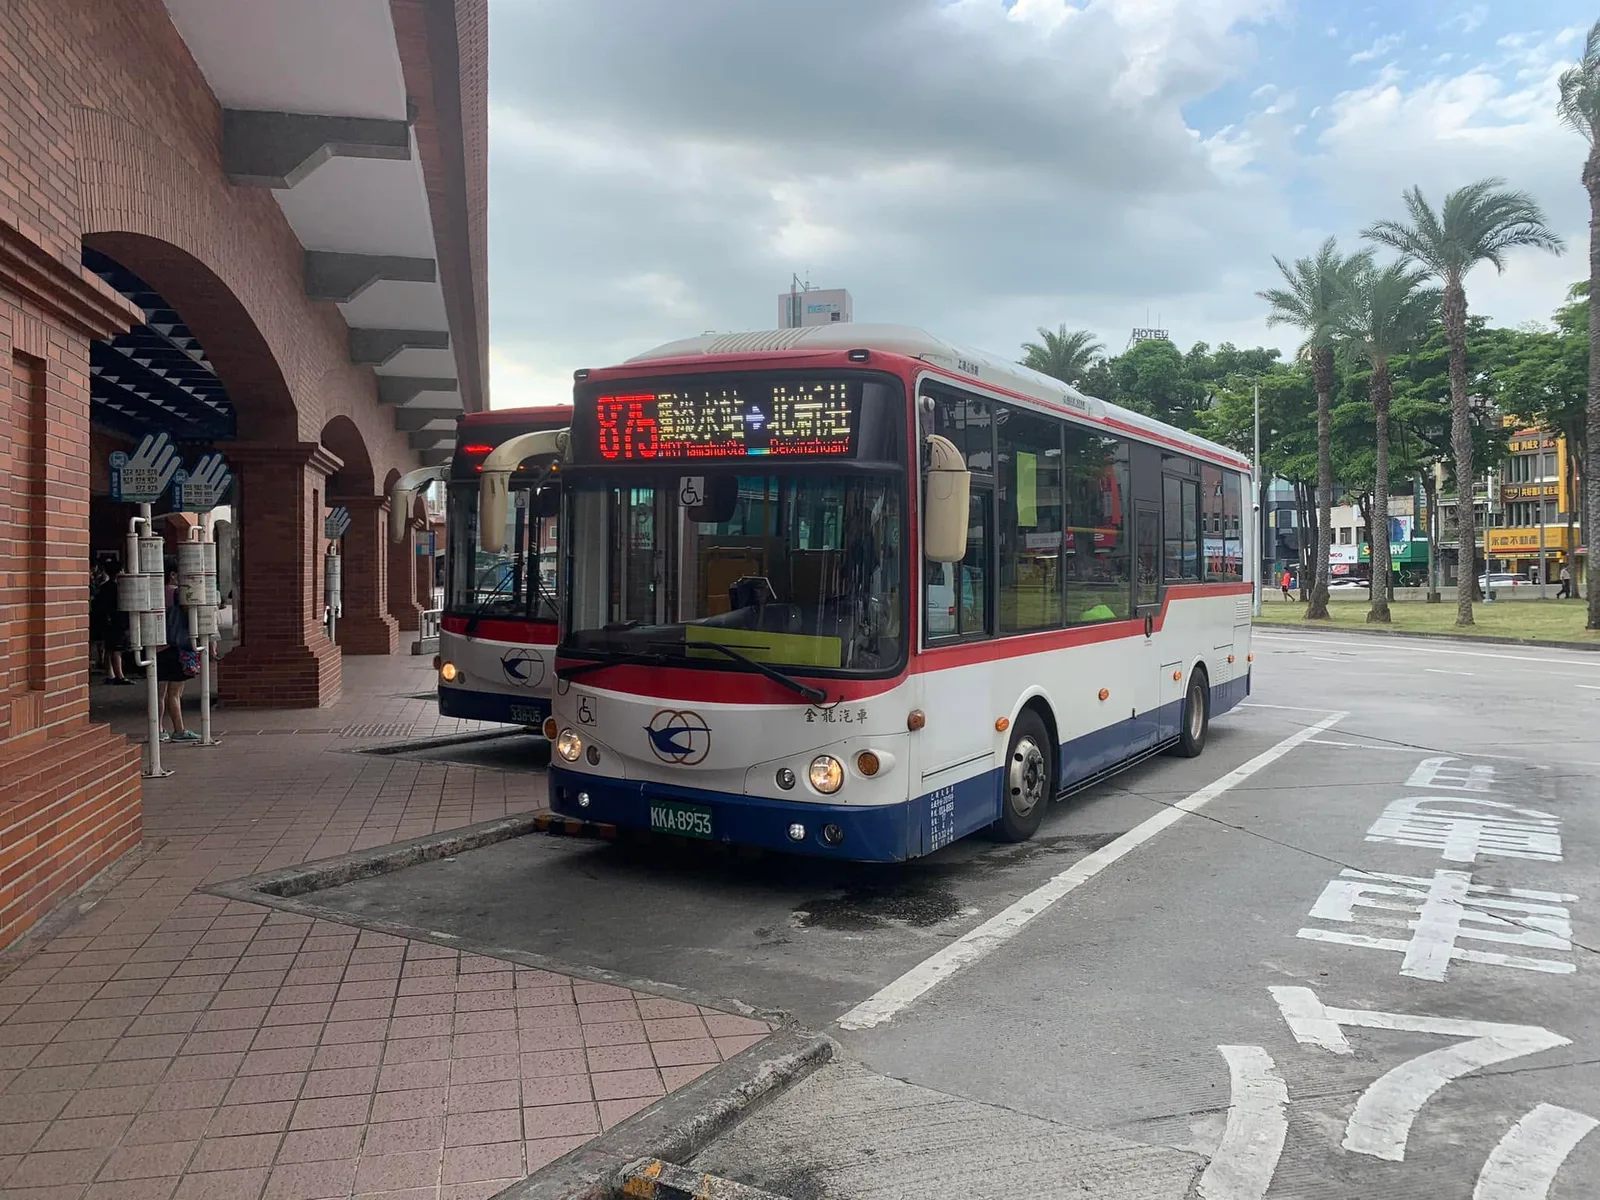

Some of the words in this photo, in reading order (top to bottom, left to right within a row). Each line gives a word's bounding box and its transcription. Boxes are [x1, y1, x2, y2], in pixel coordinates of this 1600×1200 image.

[597, 394, 658, 458] 875
[804, 708, 868, 724] 金龍汽車
